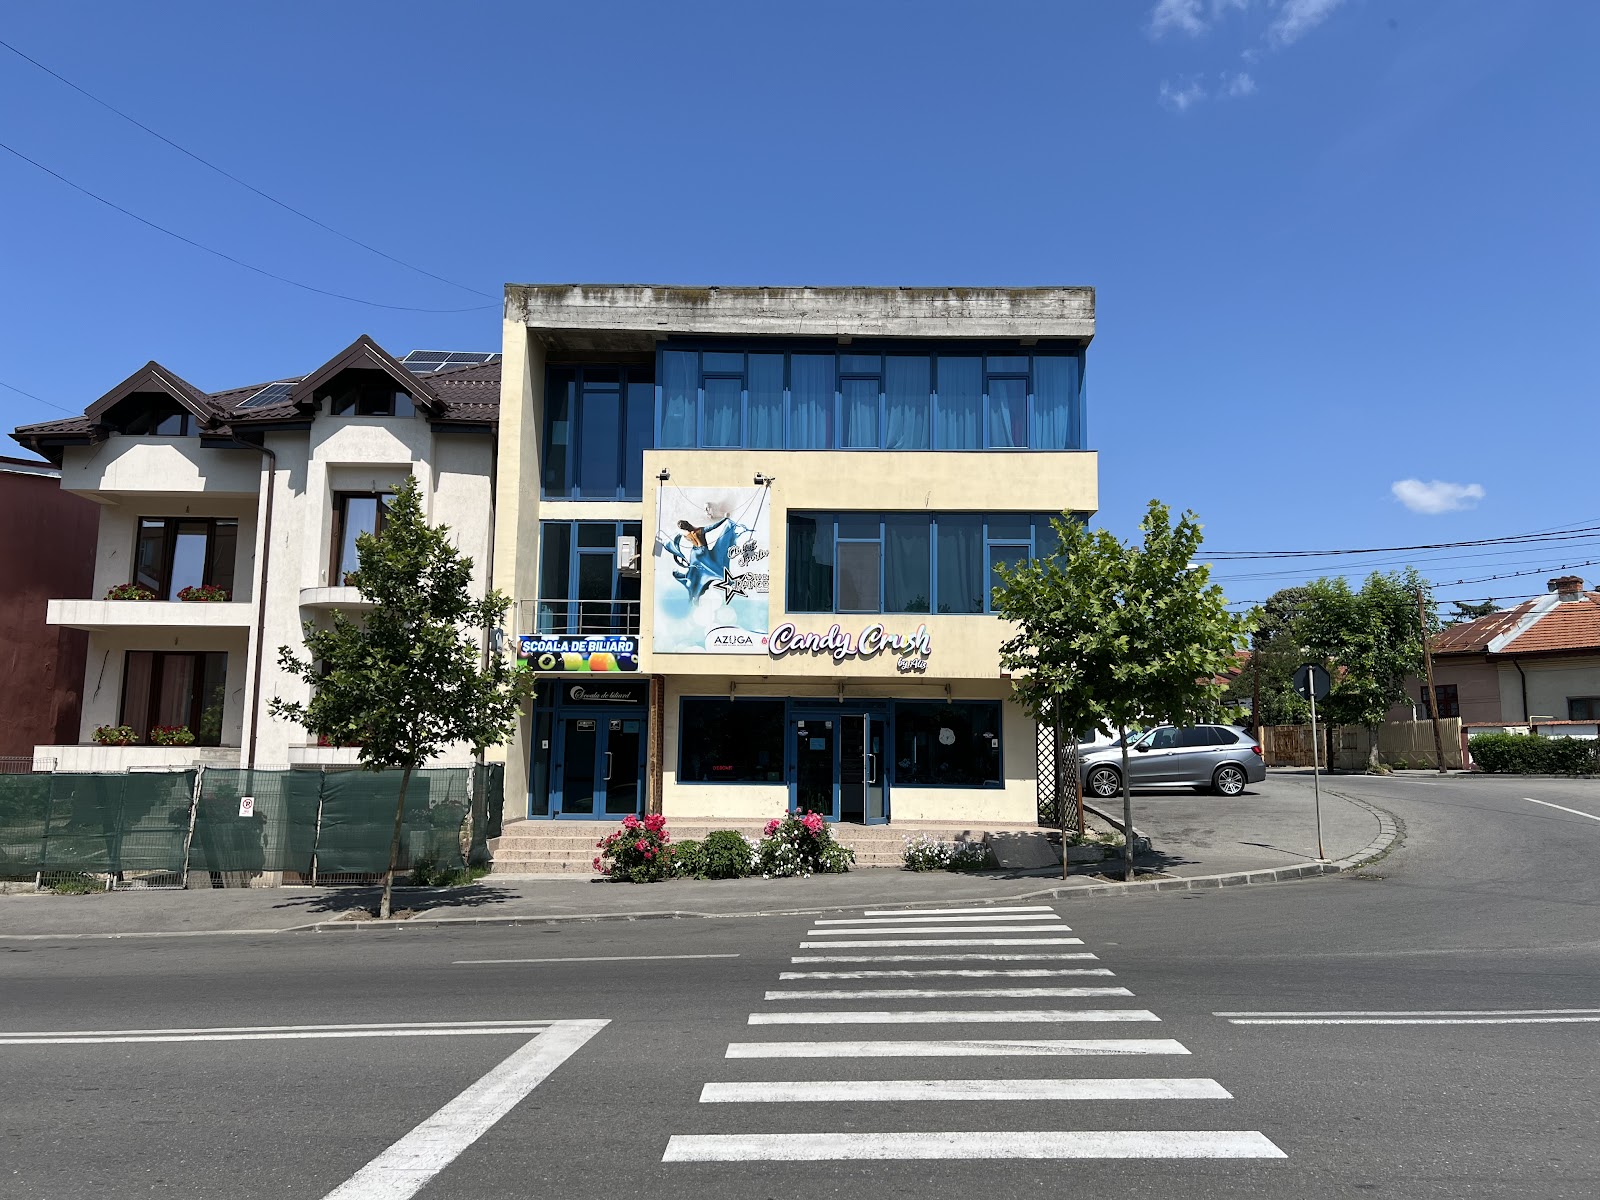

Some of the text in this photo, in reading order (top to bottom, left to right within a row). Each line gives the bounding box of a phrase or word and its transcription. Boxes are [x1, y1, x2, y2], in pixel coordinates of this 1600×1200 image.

[714, 635, 753, 644] AZUGA
[769, 622, 931, 659] Candy Crush
[571, 641, 587, 652] DE
[588, 641, 634, 652] BILIARD
[898, 657, 909, 670] by
[601, 691, 609, 699] de
[609, 691, 632, 699] biliard
